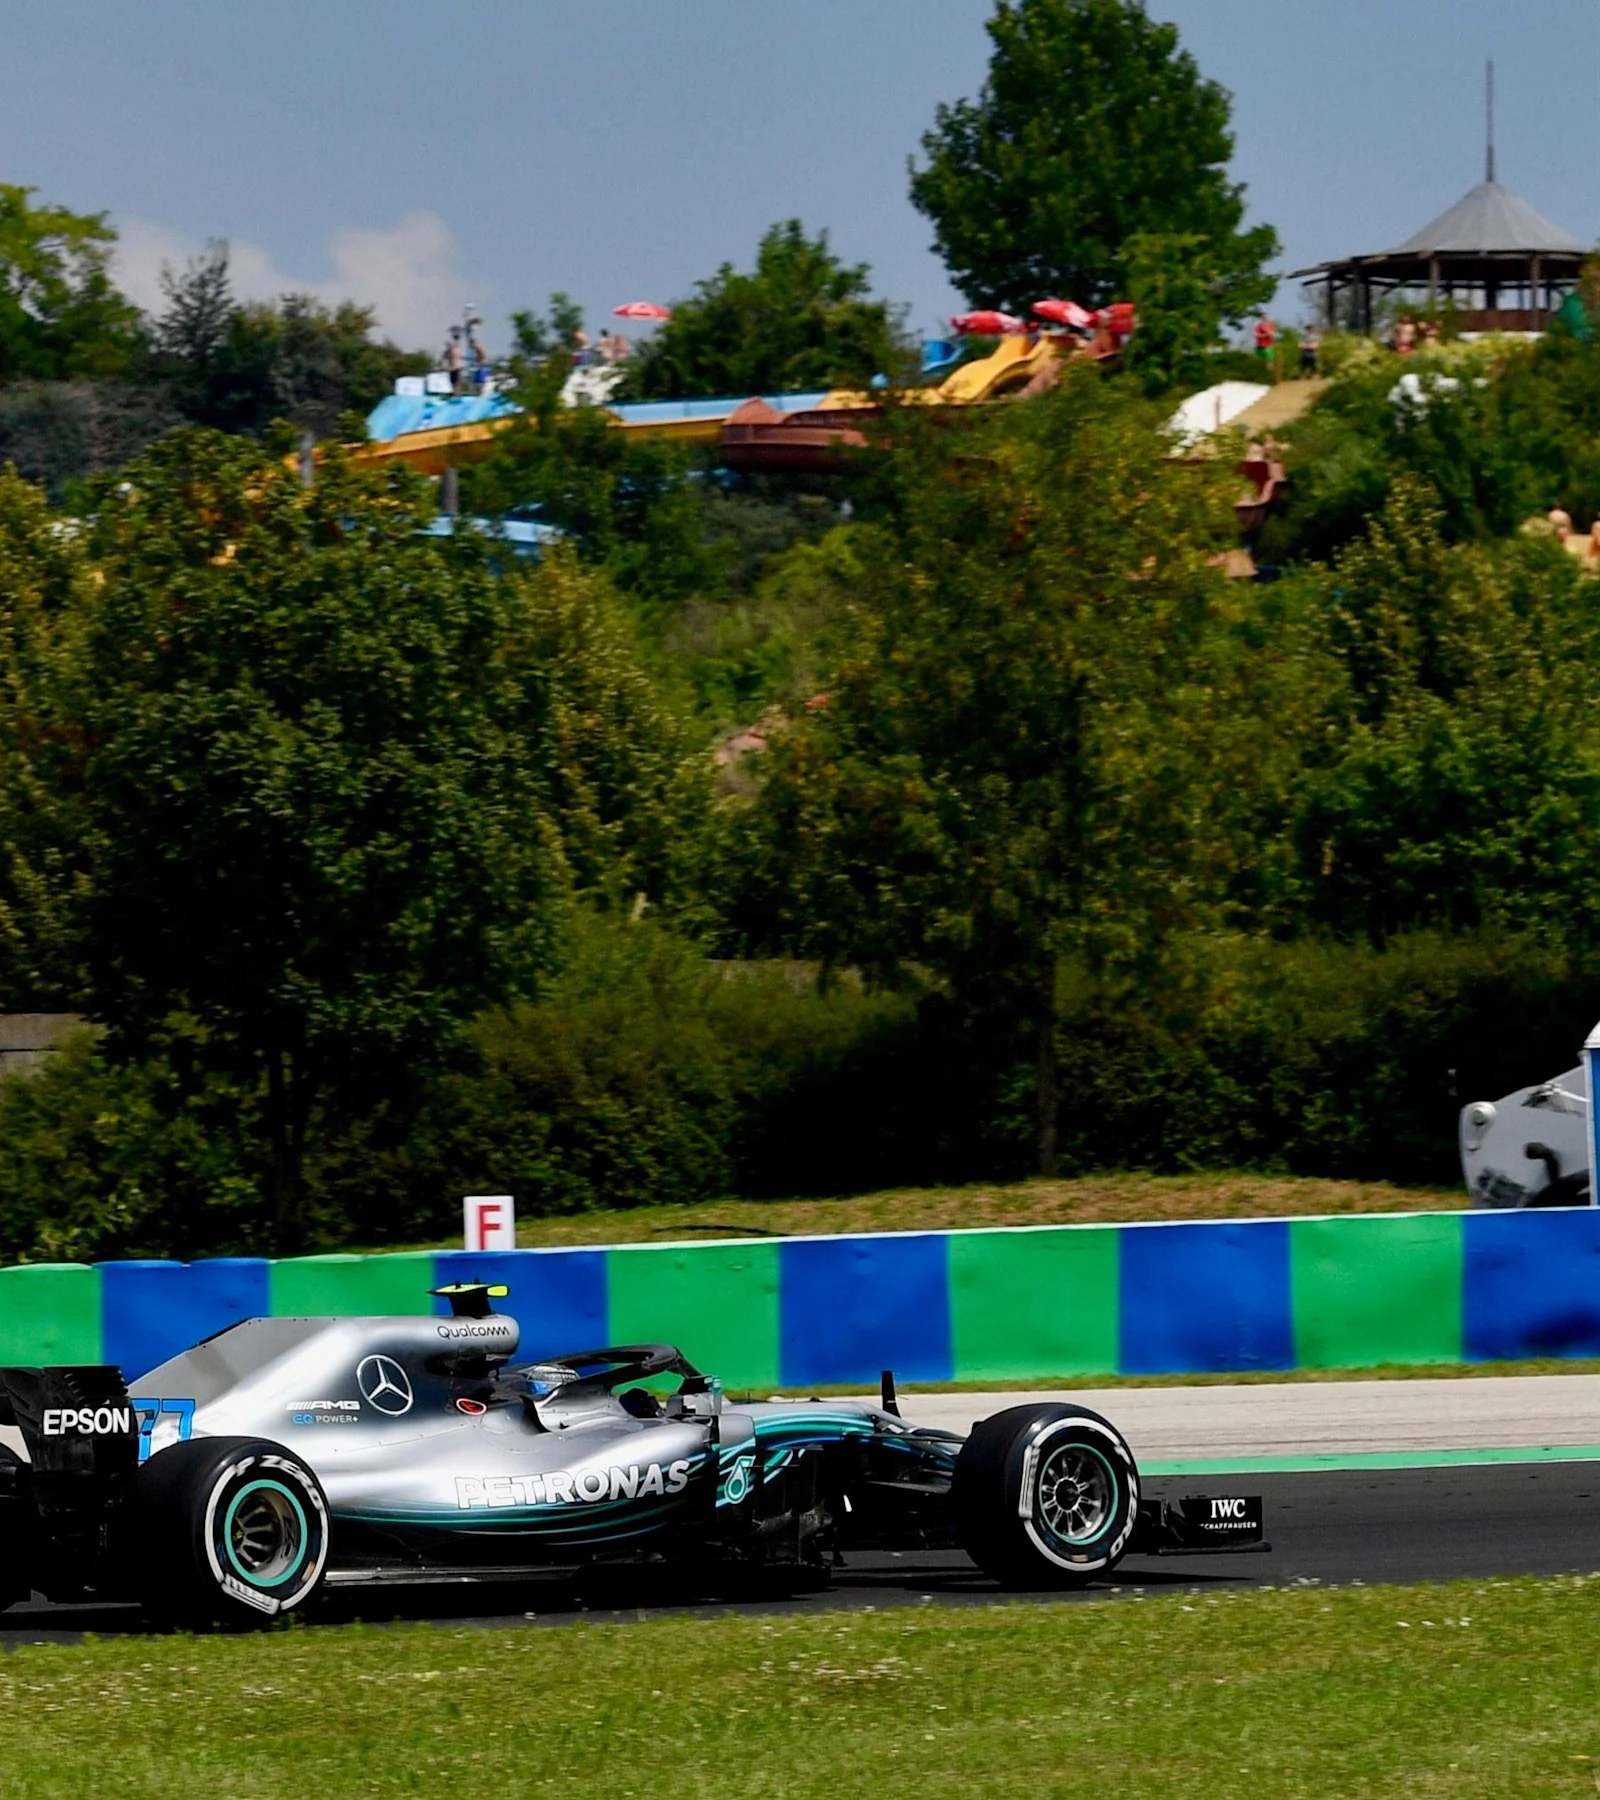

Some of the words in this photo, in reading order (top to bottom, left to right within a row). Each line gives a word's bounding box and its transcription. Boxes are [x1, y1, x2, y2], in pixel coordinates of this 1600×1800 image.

[478, 1205, 502, 1251] F
[437, 1325, 510, 1340] Qualcomm
[43, 1407, 130, 1436] EPSON
[310, 1400, 360, 1411] AMG
[131, 1398, 196, 1462] 77
[259, 1454, 322, 1511] ZERO
[455, 1459, 690, 1510] PETRONAS
[1210, 1499, 1246, 1518] IWC
